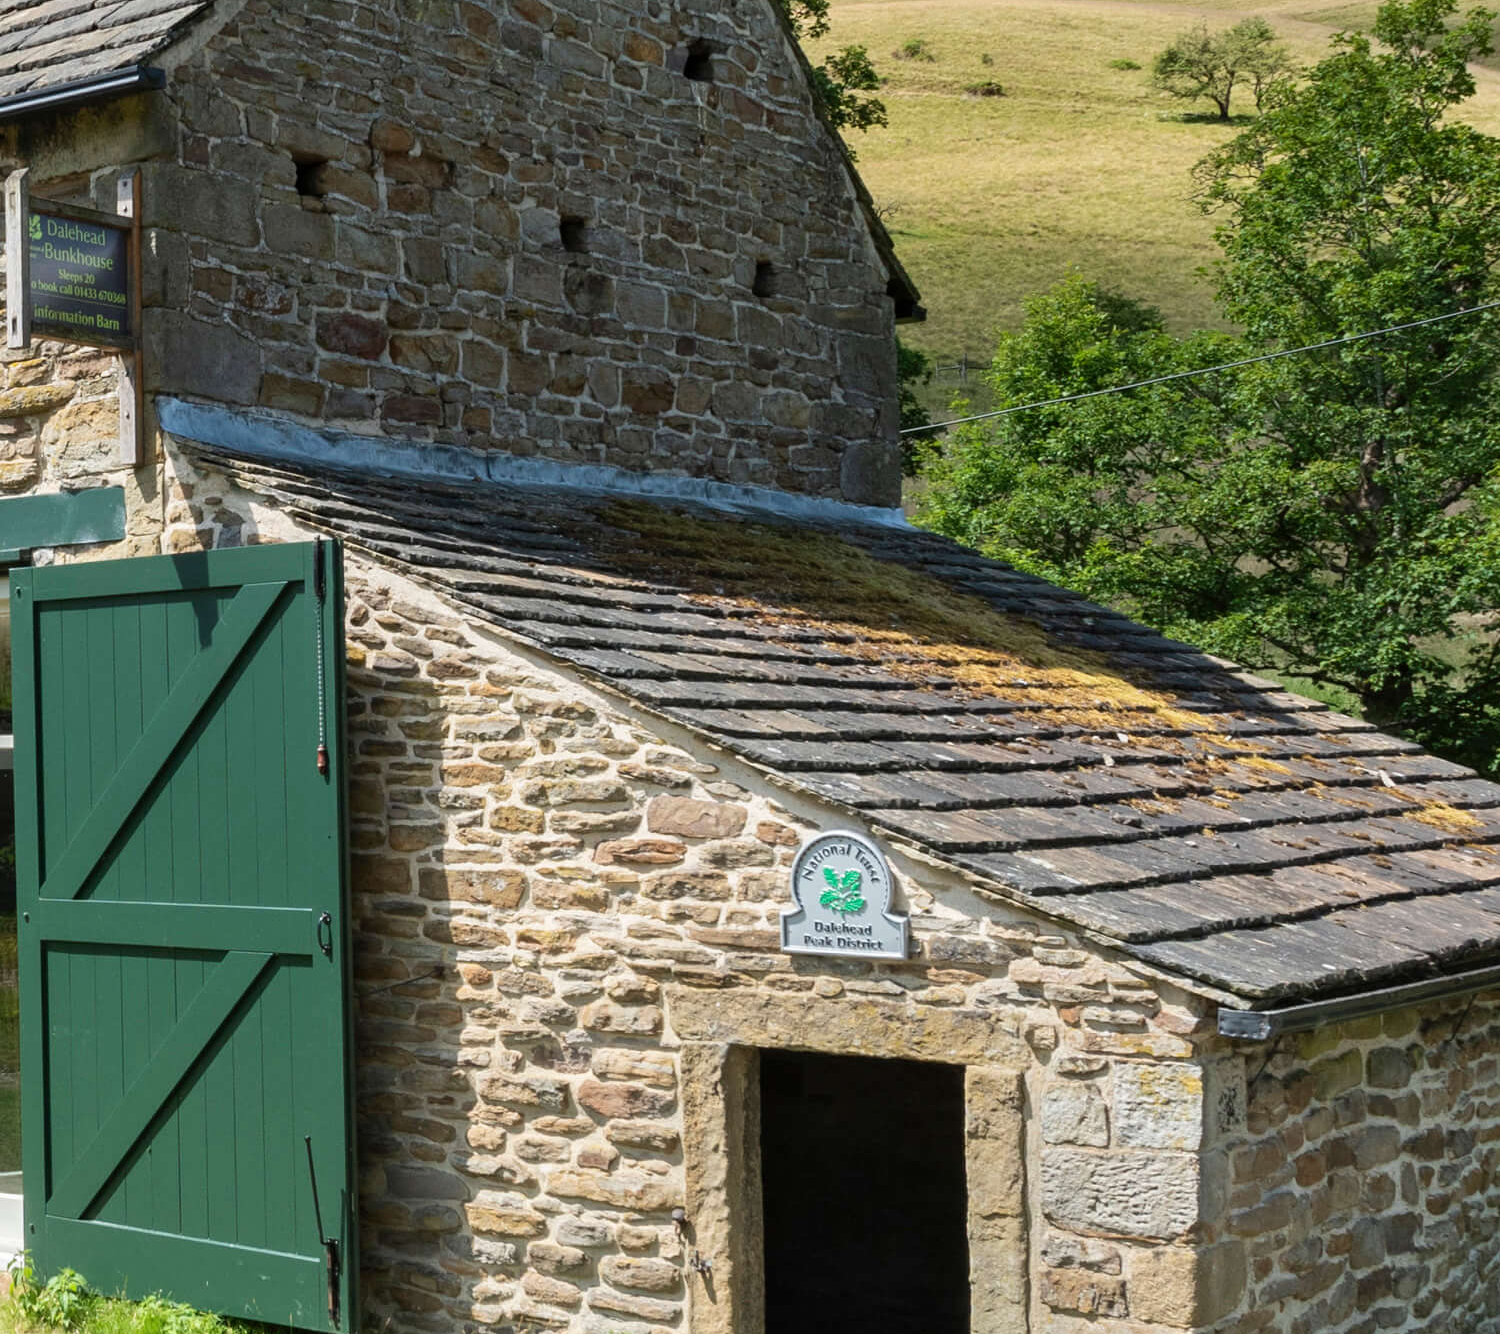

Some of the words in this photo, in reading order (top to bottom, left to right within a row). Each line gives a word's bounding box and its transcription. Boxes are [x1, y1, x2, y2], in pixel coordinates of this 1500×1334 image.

[47, 219, 106, 246] Dalehead
[45, 242, 114, 270] Bunkhouse
[59, 268, 84, 284] Sleeps
[84, 273, 96, 284] 20
[31, 280, 37, 288] o
[38, 279, 57, 291] book
[59, 284, 73, 294] call
[74, 286, 97, 299] 01433
[96, 314, 120, 330] Barn
[801, 843, 852, 881] National
[855, 847, 880, 884] Trust
[814, 921, 873, 936] Dalehead
[804, 935, 833, 947] Peak
[837, 937, 883, 950] District
